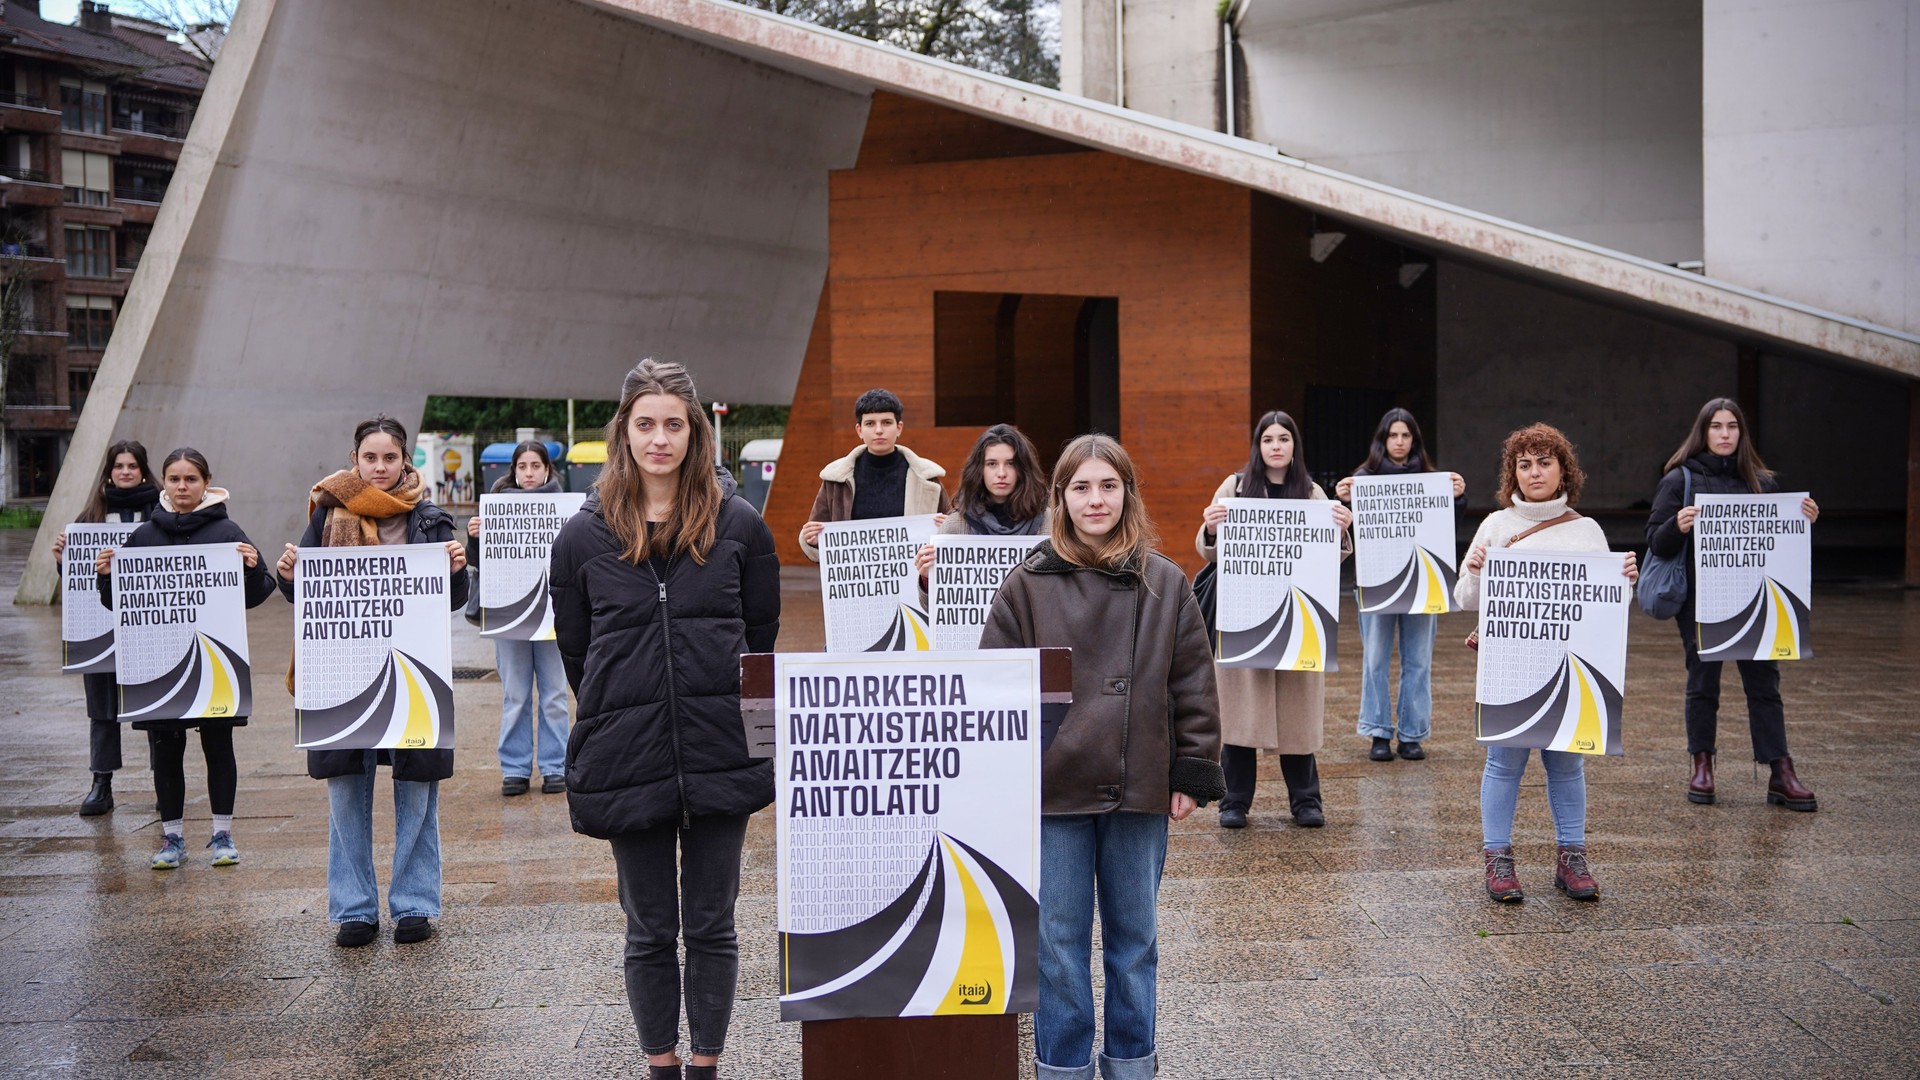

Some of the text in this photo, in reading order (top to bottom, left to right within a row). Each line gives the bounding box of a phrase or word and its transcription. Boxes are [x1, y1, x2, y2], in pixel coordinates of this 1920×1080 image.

[1356, 482, 1425, 498] INDARKERIA
[485, 503, 556, 516] INDARKERIA
[1357, 495, 1449, 512] MATXISTAREKIN
[1700, 503, 1778, 518] INDARKERIA
[1358, 510, 1423, 526] AMAITZEKO
[1700, 519, 1805, 535] MATXISTAREKIN
[68, 532, 132, 546] INDARKE
[485, 532, 554, 545] AMAITZEKO
[825, 527, 909, 548] INDARKERIA
[1223, 525, 1335, 543] MATXISTAREKIN
[1359, 525, 1416, 540] ANTOLATU
[485, 546, 546, 559] ANTOLATU
[1223, 543, 1302, 560] AMAITZEKO
[1700, 536, 1775, 551] AMAITZEKO
[118, 555, 207, 574] INDARKERIA
[302, 556, 407, 578] INDARKERIA
[1223, 559, 1292, 576] ANTOLATU
[1488, 559, 1588, 581] INDARKERIA
[1701, 553, 1766, 568] ANTOLATU
[118, 571, 238, 592] MATXISTAREKIN
[827, 562, 908, 582] AMAITZEKO
[302, 576, 444, 599] MATXISTAREKIN
[829, 580, 900, 600] ANTOLATU
[1487, 579, 1622, 604] MATXISTAREKIN
[119, 590, 206, 609] AMAITZEKO
[302, 598, 404, 619] AMAITZEKO
[120, 608, 197, 627] ANTOLATU
[1486, 600, 1583, 622] AMAITZEKO
[302, 619, 393, 640] ANTOLATU
[1485, 620, 1570, 641] ANTOLATU
[789, 674, 967, 708] INDARKERIA
[789, 709, 1028, 745] MATXISTAREKIN
[789, 747, 960, 781] AMAITZEKO
[789, 783, 940, 818] ANTOLATU
[958, 983, 986, 997] itaia
